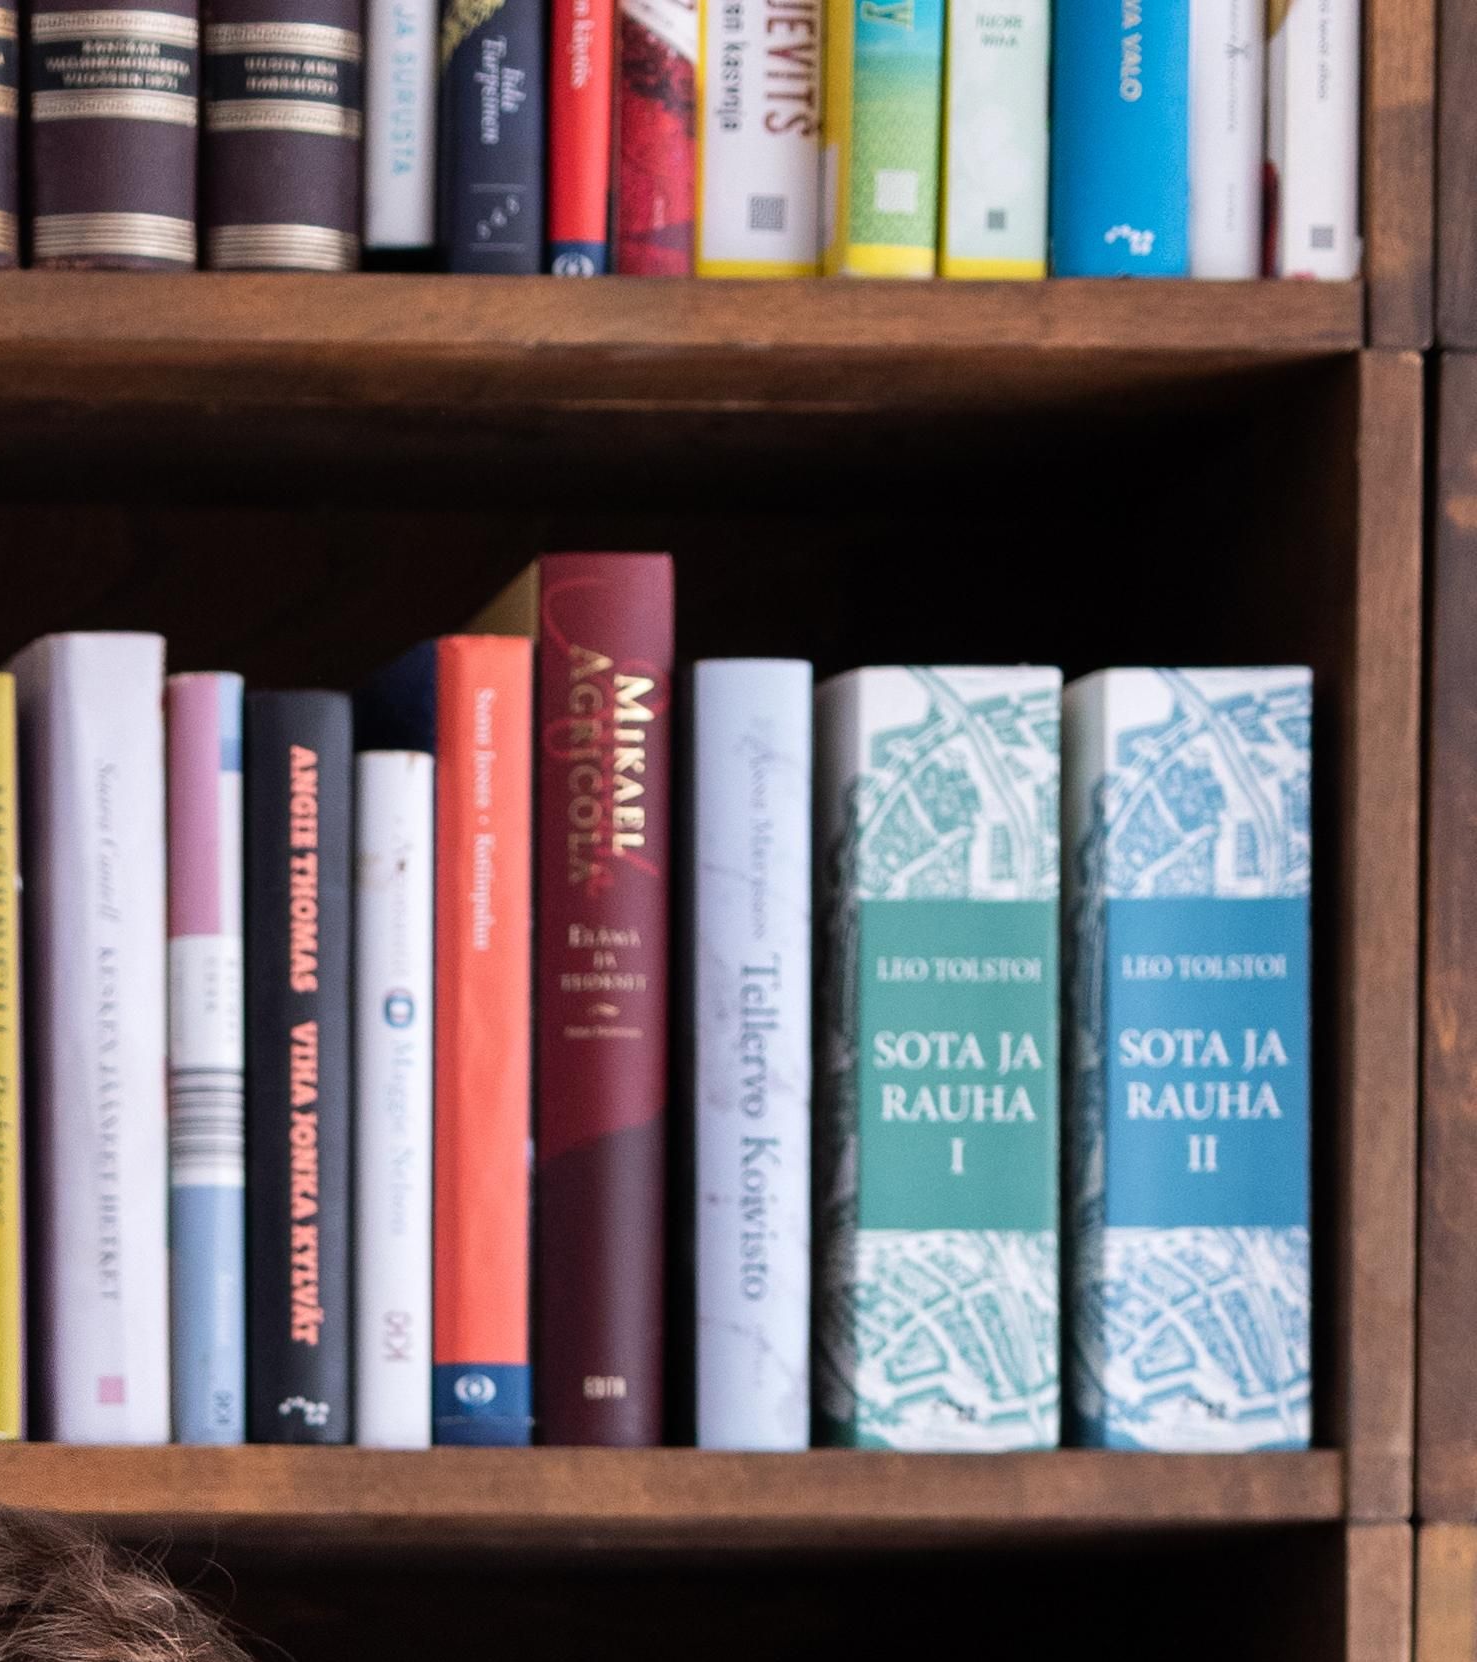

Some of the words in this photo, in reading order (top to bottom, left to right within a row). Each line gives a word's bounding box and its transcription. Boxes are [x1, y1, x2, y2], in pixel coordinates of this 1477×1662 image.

[288, 744, 320, 838] ANGIE
[566, 645, 616, 886] AGRICOLA
[612, 673, 657, 858] MIKAEL
[288, 841, 320, 994] THOMAS
[875, 956, 926, 983] LEO
[930, 956, 1043, 983] TOLSTOI
[1121, 954, 1172, 982] LEO
[1176, 954, 1288, 982] TOLSTOI
[289, 1022, 320, 1103] VIHA
[740, 956, 783, 1121] Tellervo
[873, 1029, 986, 1071] SOTA
[997, 1029, 1044, 1074] JA
[1118, 1027, 1231, 1068] SOTA
[1243, 1027, 1289, 1072] JA
[881, 1082, 1037, 1122] RAUHA
[1125, 1079, 1283, 1120] RAUHA
[288, 1111, 319, 1221] JONKA
[740, 1136, 783, 1303] Koivisto
